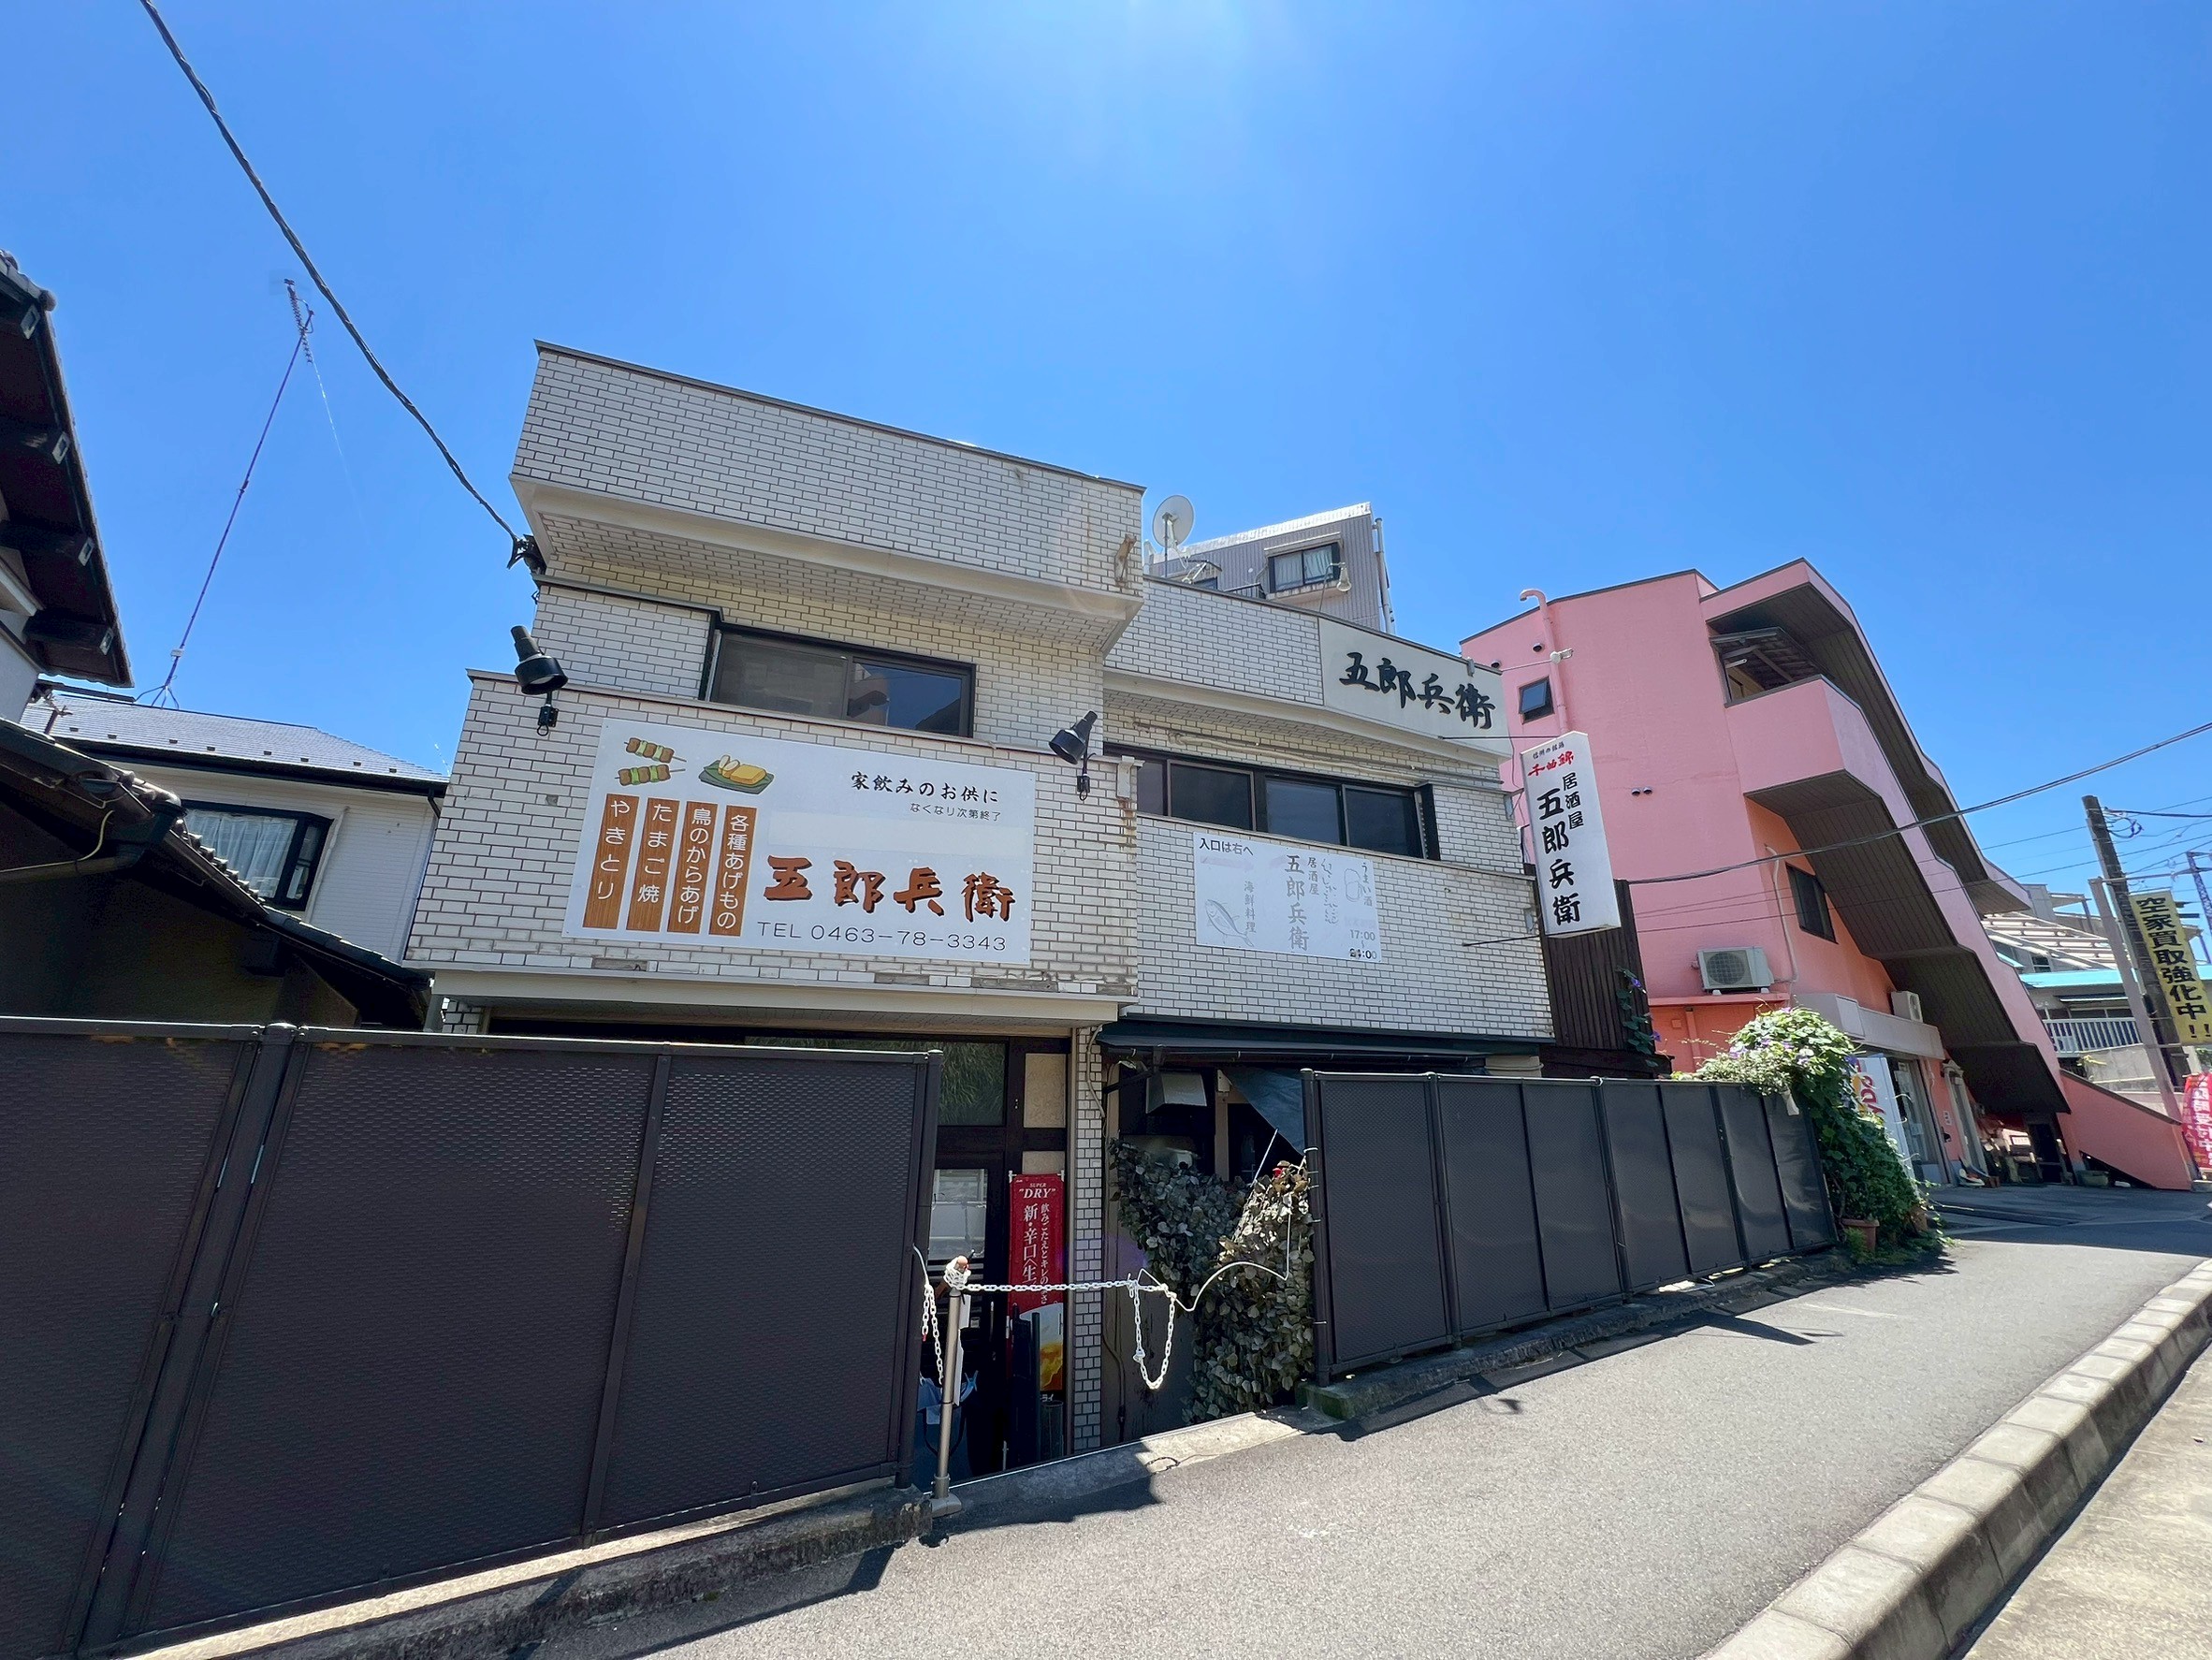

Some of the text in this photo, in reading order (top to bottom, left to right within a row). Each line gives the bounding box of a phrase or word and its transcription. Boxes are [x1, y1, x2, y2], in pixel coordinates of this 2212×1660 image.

[1339, 651, 1495, 730] 五郎兵衛
[851, 771, 999, 804] 家飲みのお供に
[910, 802, 1002, 823] なくなり次第終了
[1562, 772, 1584, 828] 居酒屋
[597, 800, 630, 900] やきとり
[637, 803, 673, 904] たまご焼
[677, 808, 712, 925] 鳥のからあげ
[717, 814, 749, 929] 各種あげもの
[1199, 837, 1254, 856] 入口は右へ
[1307, 856, 1319, 896] 居酒屋
[1537, 788, 1581, 925] 五郎兵衛
[763, 853, 1016, 923] 五郎兵衛
[1244, 881, 1257, 934] 海鮮料理
[1284, 854, 1310, 952] 五郎兵衛
[757, 921, 1006, 951] TEL 0463-78-3343
[1350, 929, 1375, 941] 17:00
